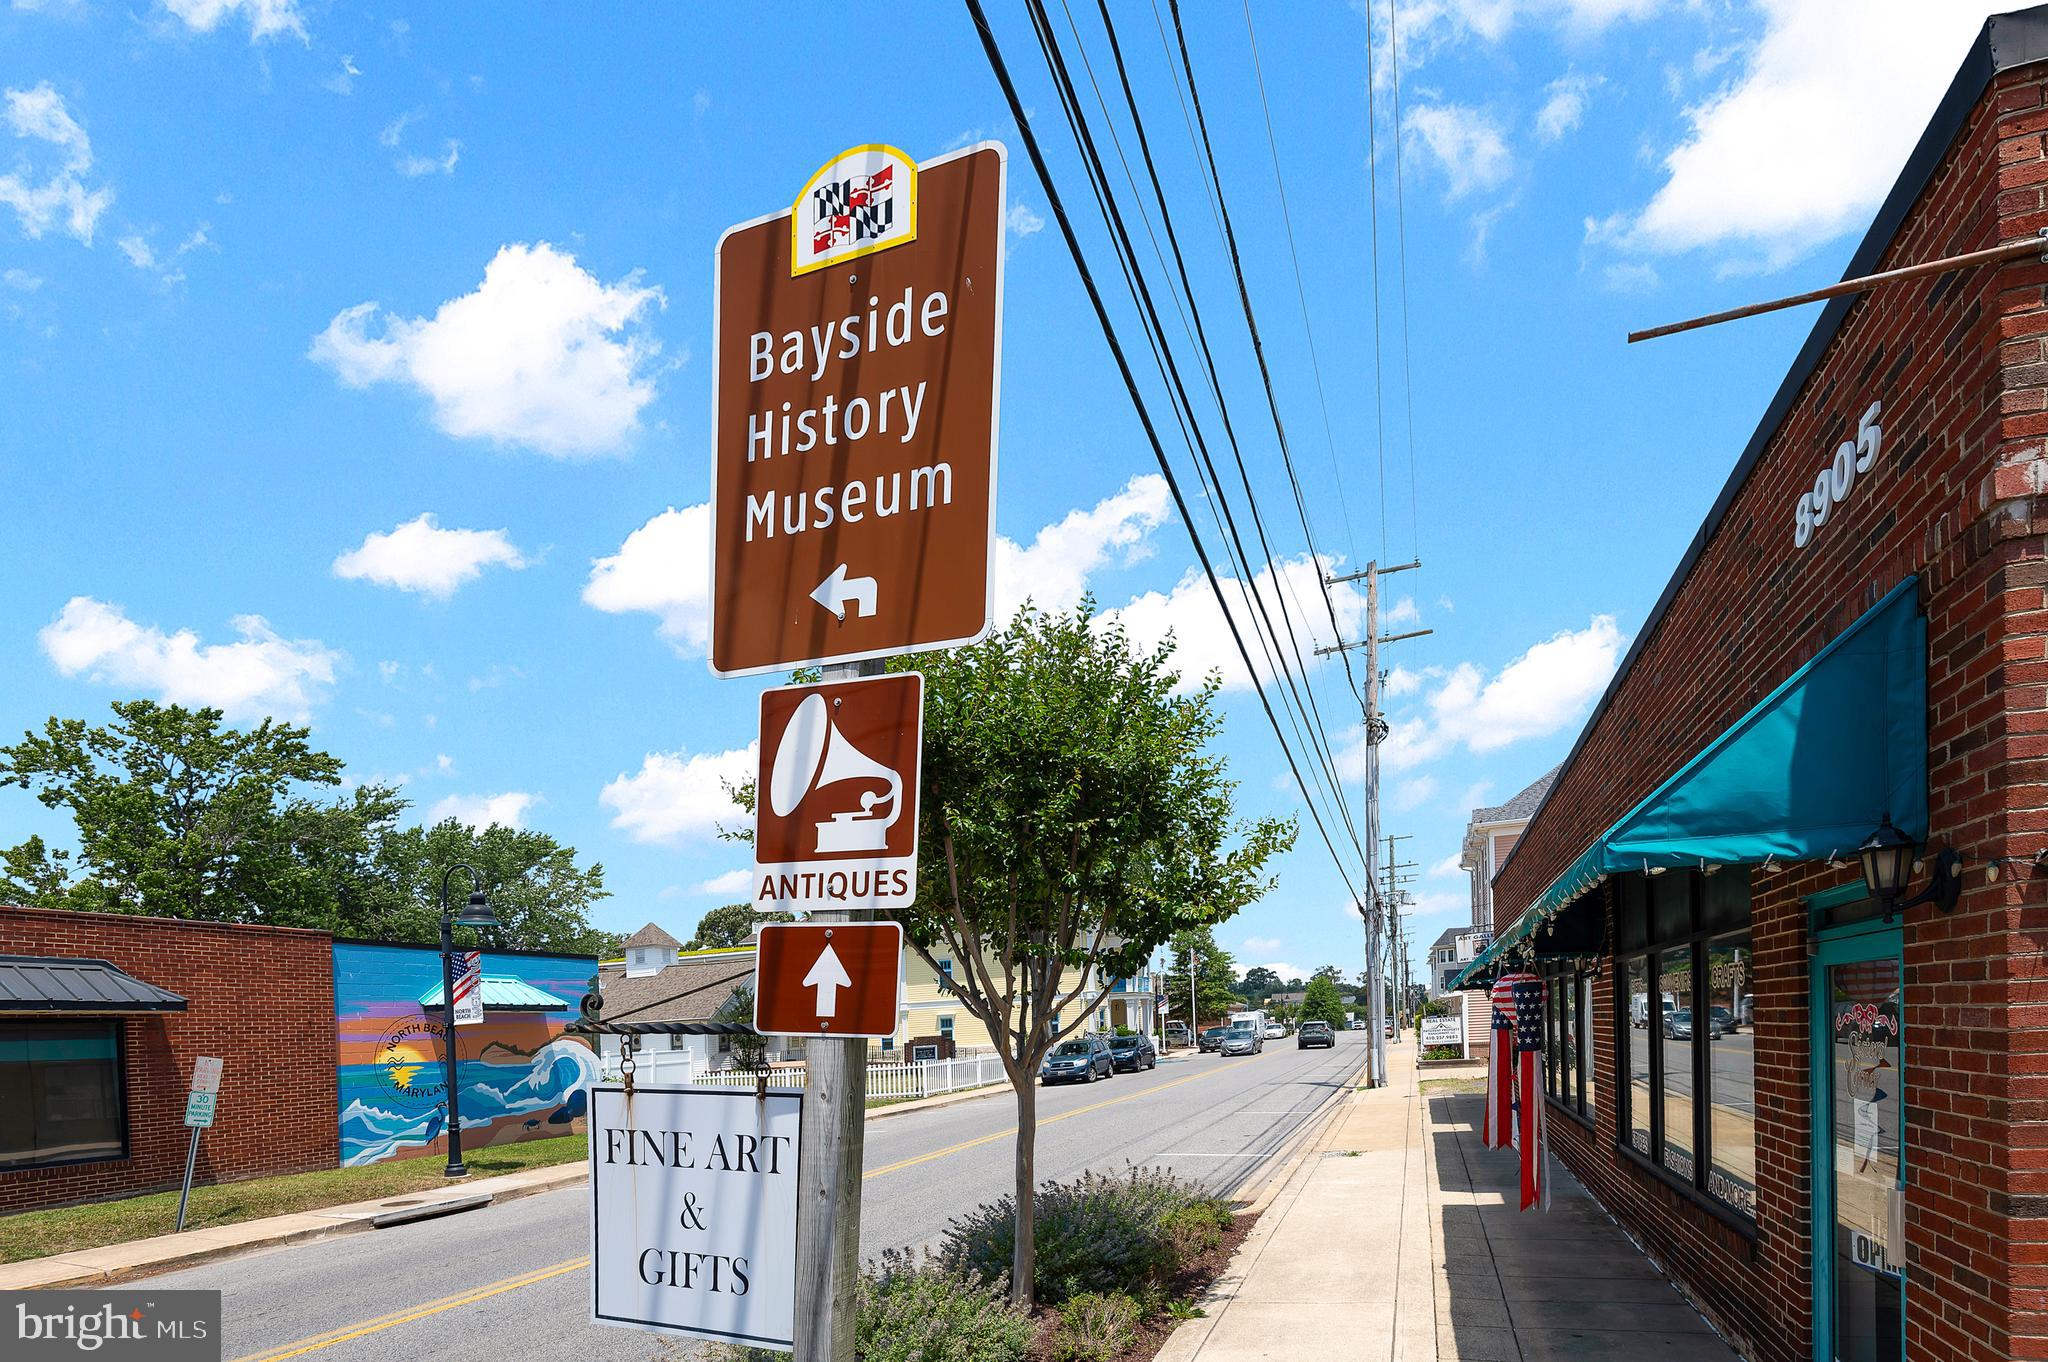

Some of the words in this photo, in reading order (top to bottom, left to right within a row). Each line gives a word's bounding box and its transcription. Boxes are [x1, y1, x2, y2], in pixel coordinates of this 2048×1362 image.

[749, 286, 949, 384] Bayside
[747, 381, 927, 463] History
[1795, 400, 1882, 549] 8905
[744, 461, 953, 543] Museum
[758, 869, 908, 901] ANTIQUES
[1711, 961, 1745, 989] CRAFTS
[386, 1023, 421, 1052] NORTH
[423, 1023, 450, 1042] BEAC
[197, 1095, 209, 1103] 30
[393, 1081, 449, 1098] MARYLAN
[604, 1128, 695, 1169] FINE
[704, 1133, 790, 1175] ART
[1708, 1170, 1724, 1199] AND
[680, 1191, 707, 1231] &
[638, 1247, 750, 1296] GIFTS
